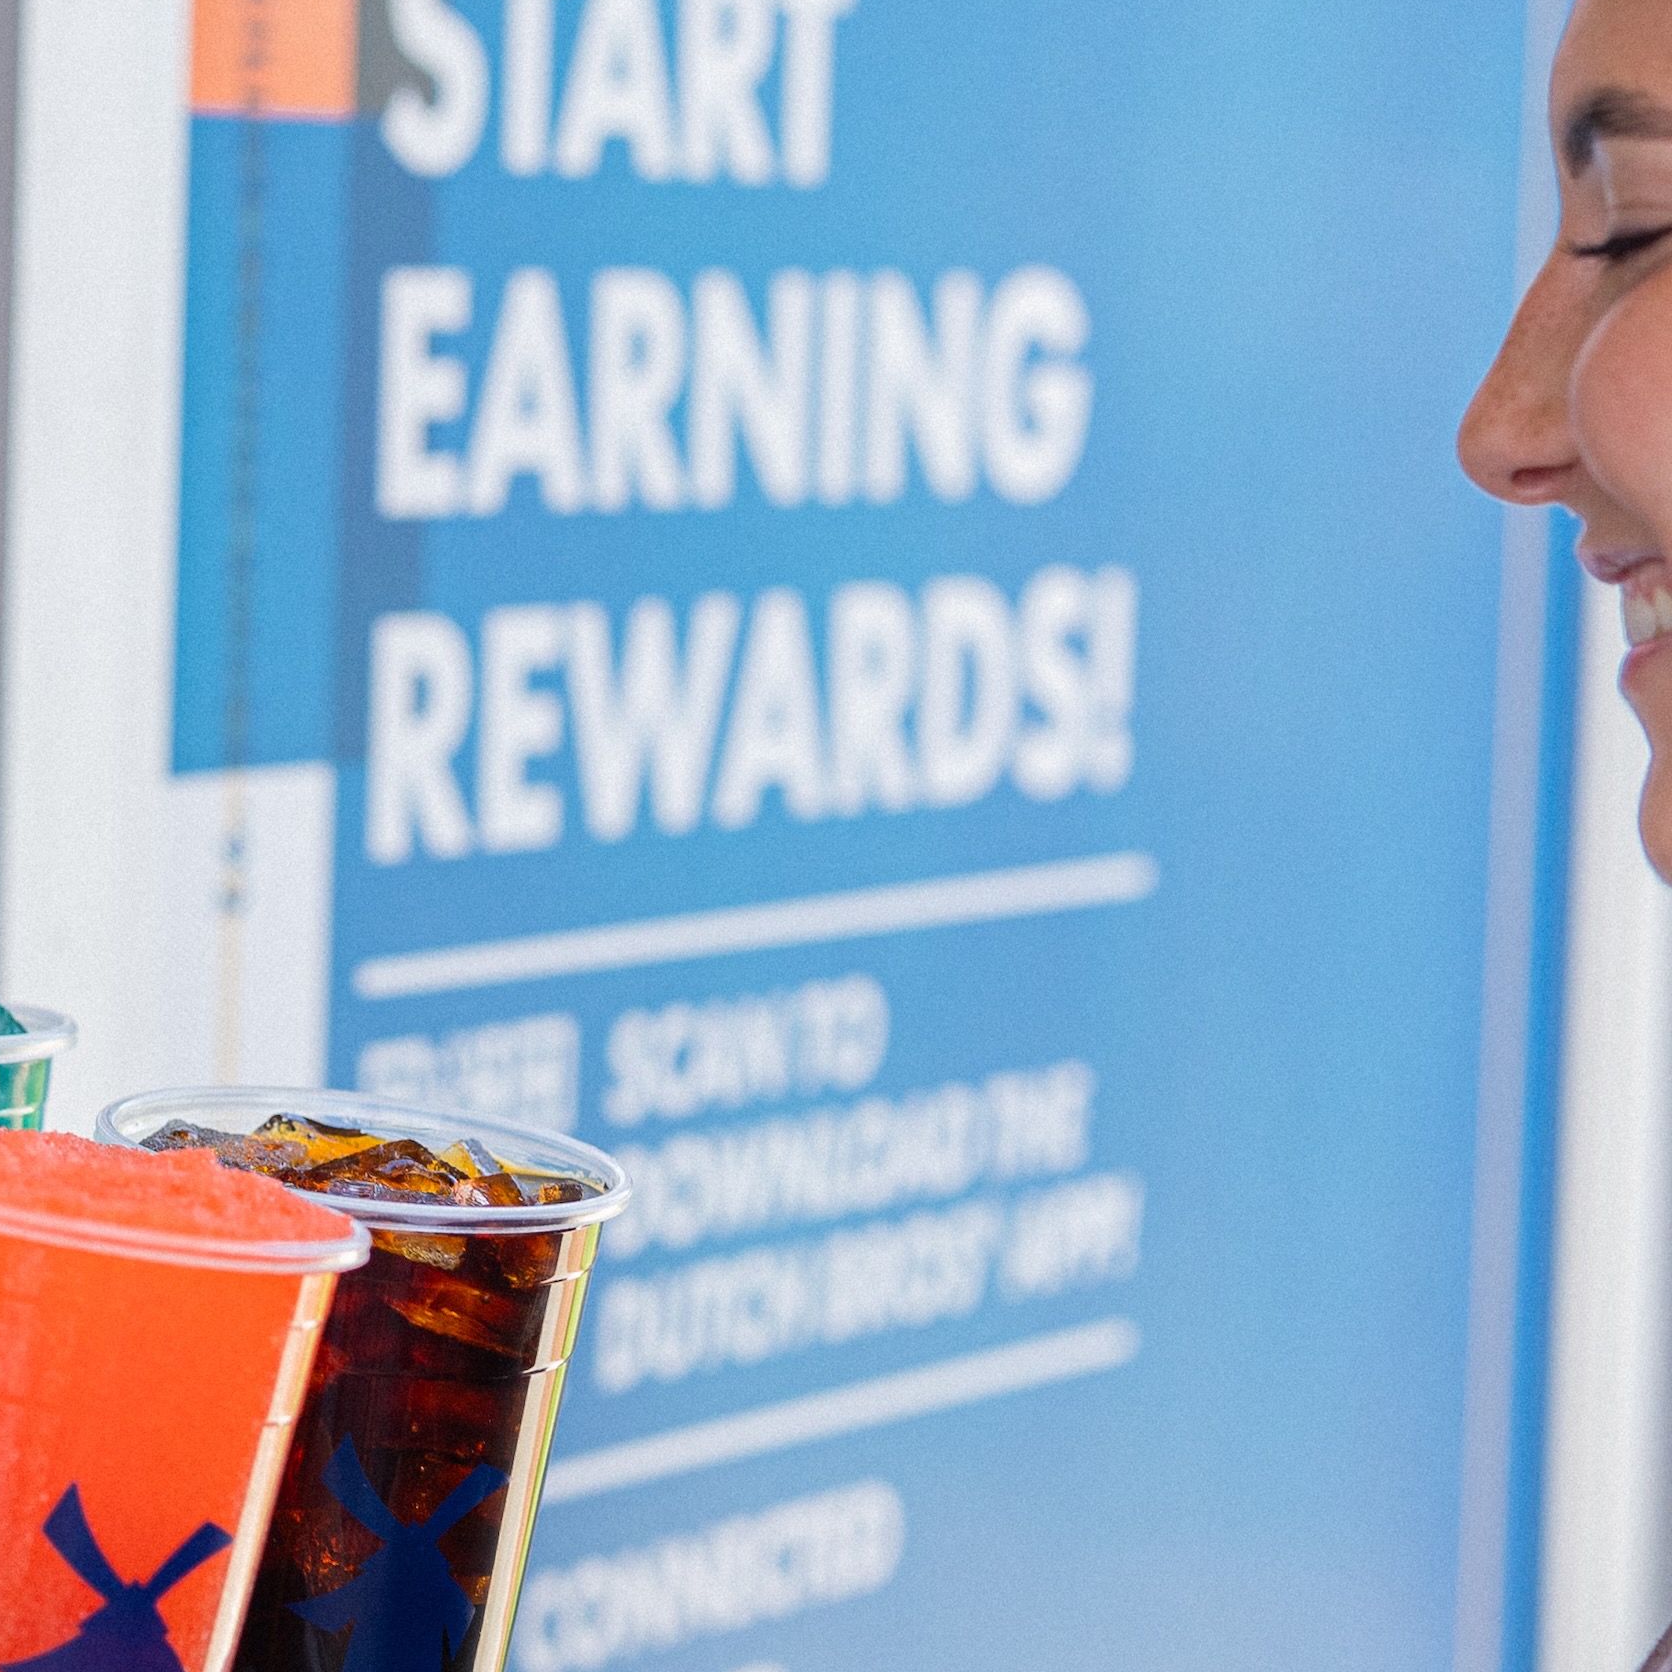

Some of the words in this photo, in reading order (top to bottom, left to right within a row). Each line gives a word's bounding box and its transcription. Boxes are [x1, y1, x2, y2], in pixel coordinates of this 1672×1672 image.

[376, 264, 1093, 519] EARNING
[365, 564, 1138, 866] REWARDS!
[604, 992, 791, 1125] SCAN
[793, 973, 889, 1096] TO
[978, 1058, 1097, 1180] THE
